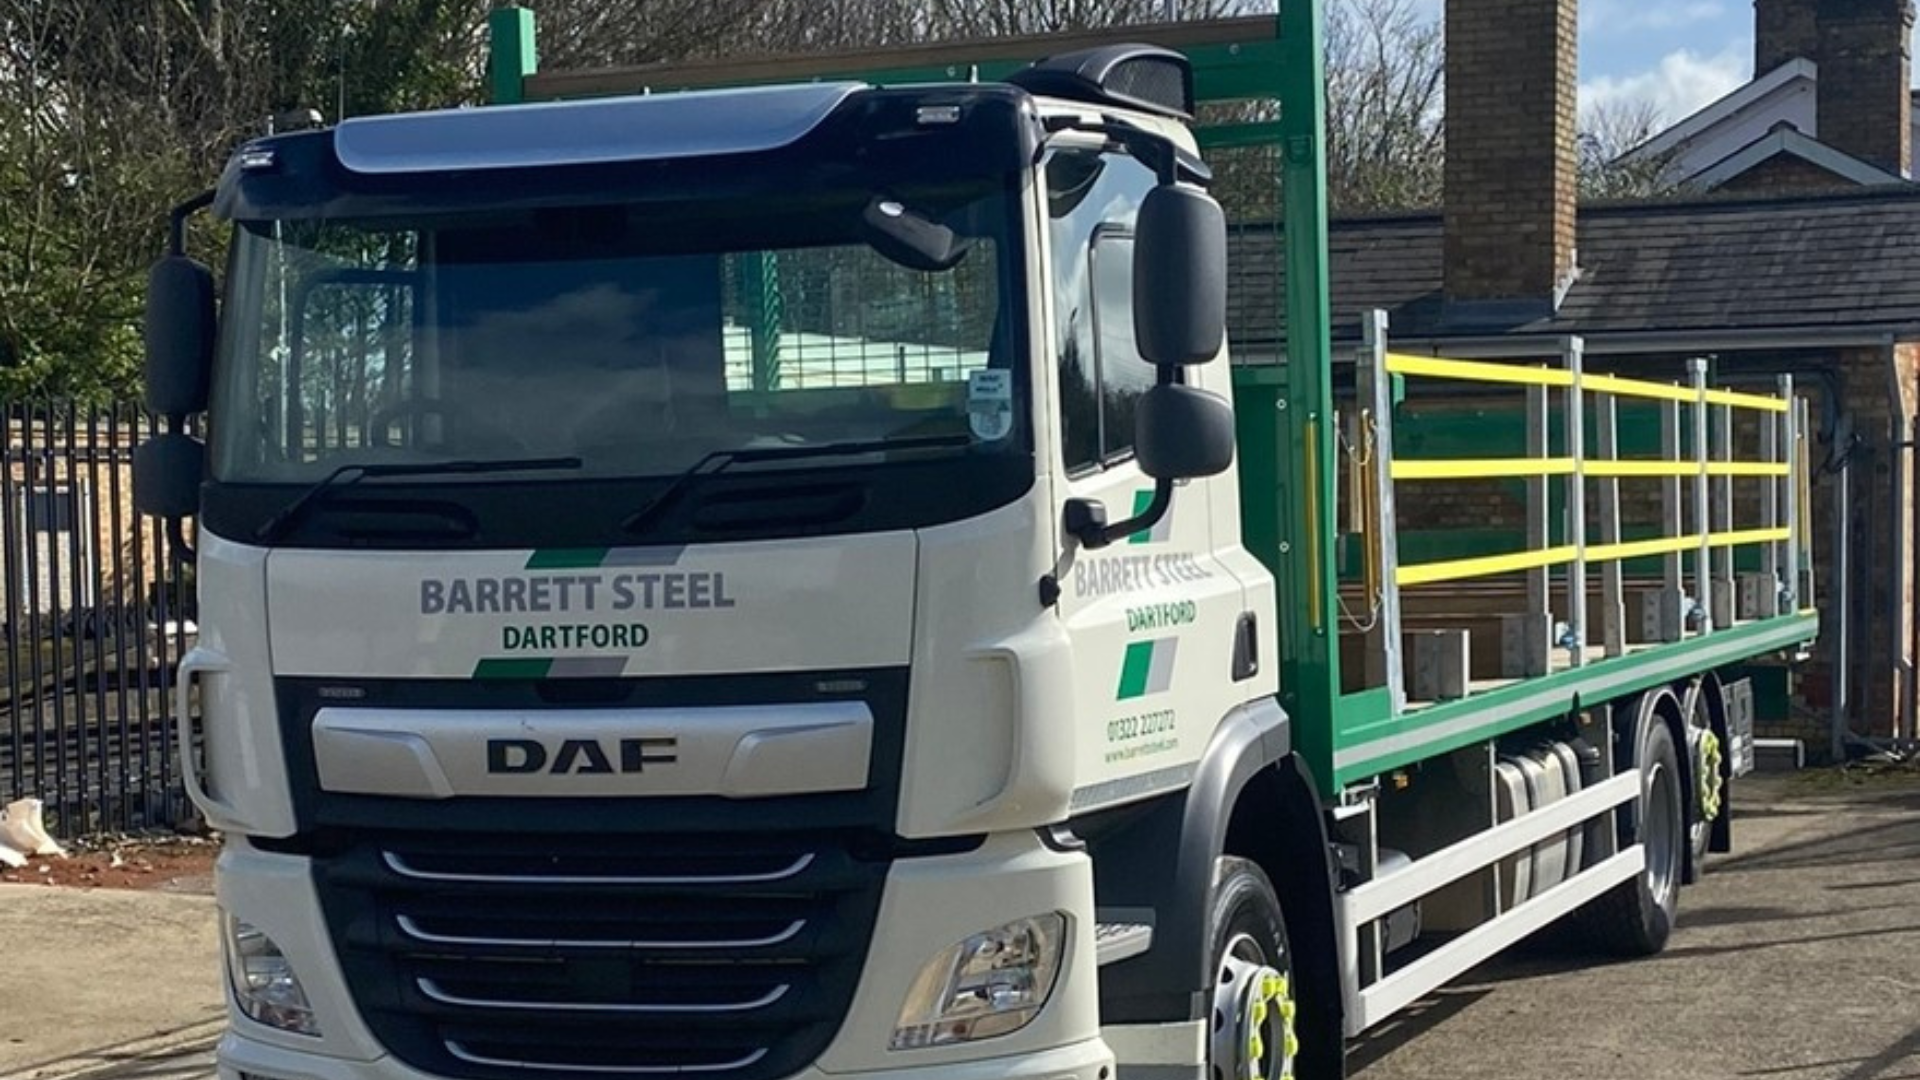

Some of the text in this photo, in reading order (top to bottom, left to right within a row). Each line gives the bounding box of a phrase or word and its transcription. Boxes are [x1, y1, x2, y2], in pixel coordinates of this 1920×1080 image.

[421, 572, 735, 614] BARRETT STEEL
[1075, 552, 1213, 598] BARRETT STEEL
[1125, 599, 1196, 632] DARTFORD
[503, 624, 649, 649] DARTFORD
[487, 737, 678, 774] DAF
